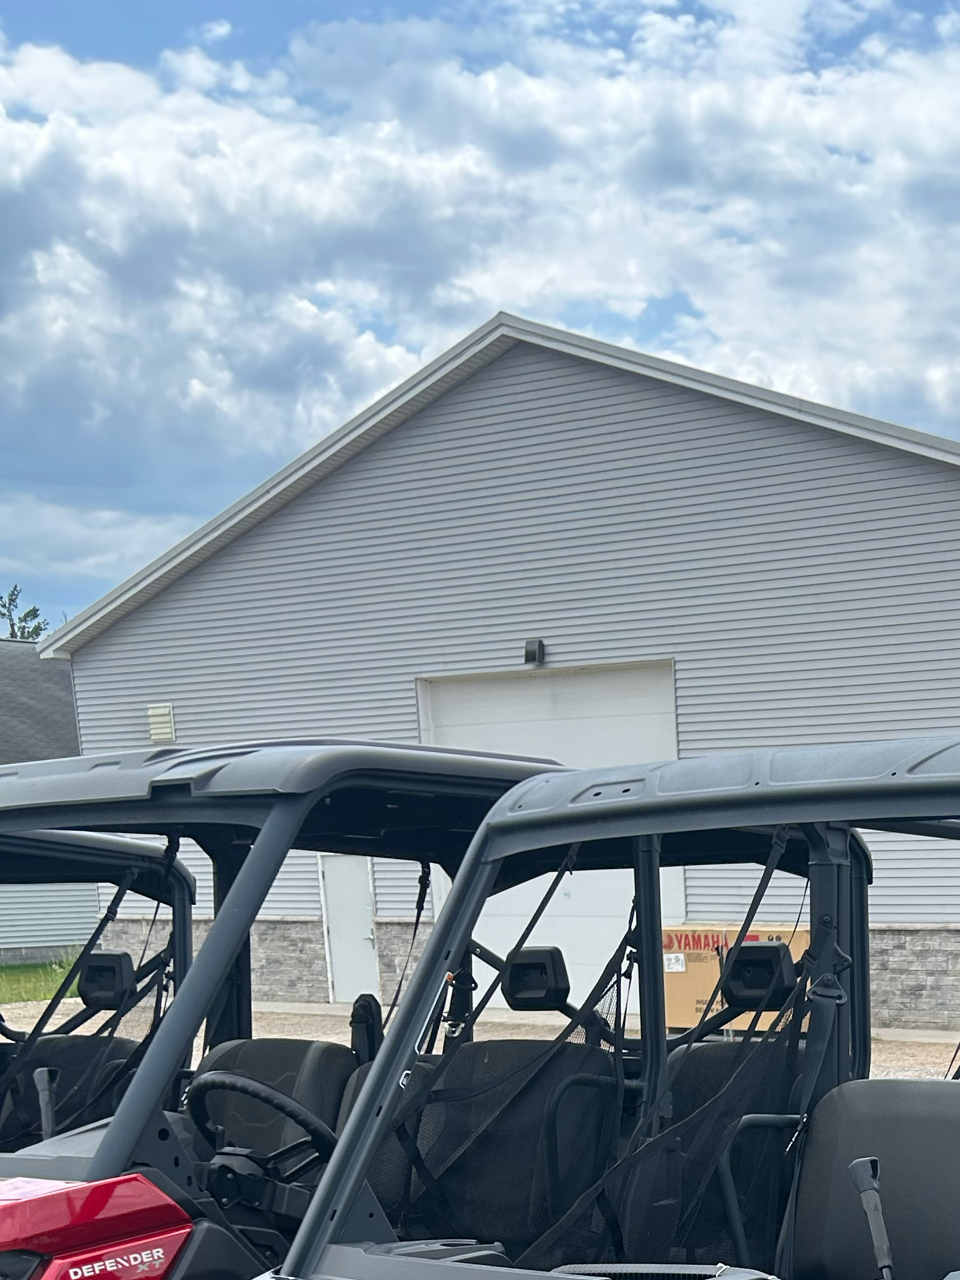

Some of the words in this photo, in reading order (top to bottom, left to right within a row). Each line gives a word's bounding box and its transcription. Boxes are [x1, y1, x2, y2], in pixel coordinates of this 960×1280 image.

[674, 932, 730, 951] YAMAHA
[68, 1248, 164, 1280] DEFENDER
[136, 1259, 164, 1273] XT
